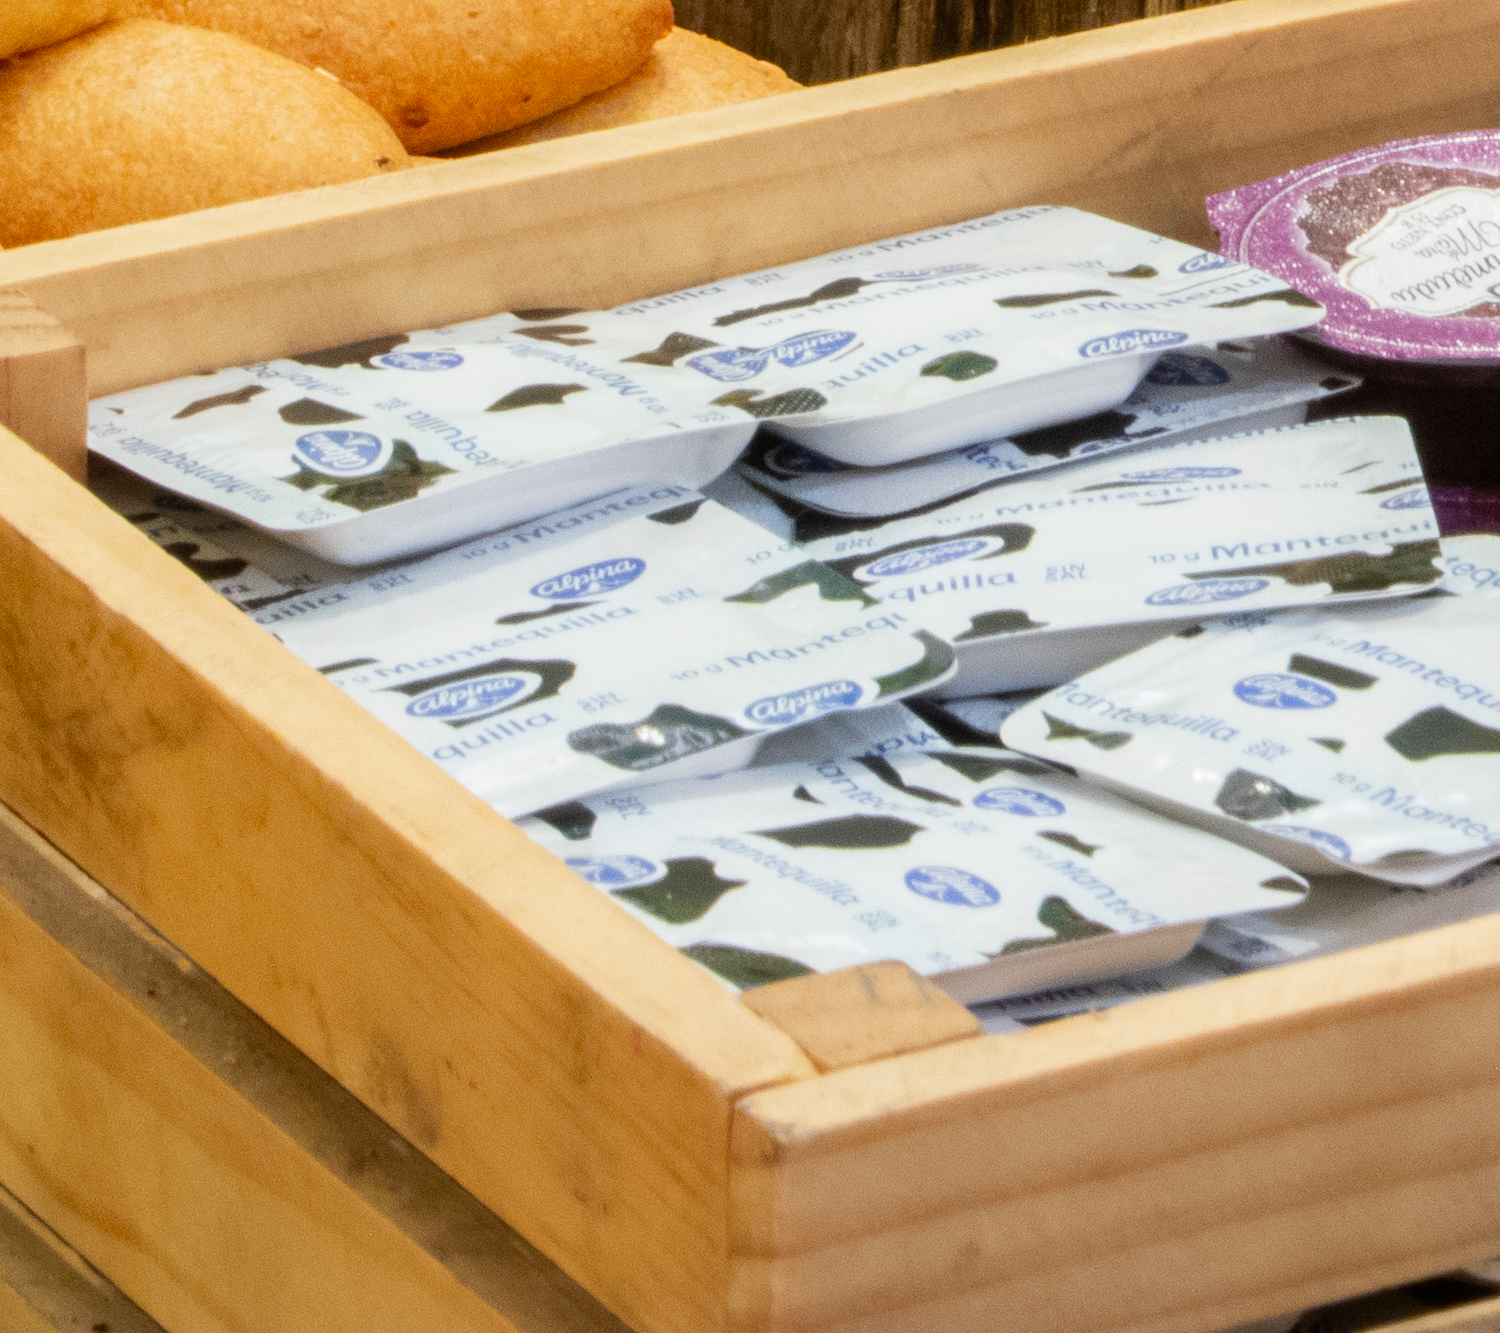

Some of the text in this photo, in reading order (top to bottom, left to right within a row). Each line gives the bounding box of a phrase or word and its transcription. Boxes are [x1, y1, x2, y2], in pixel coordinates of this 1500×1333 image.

[614, 285, 723, 318] quilla
[886, 570, 1017, 604] quilla
[374, 603, 638, 680] Mantequilla
[432, 712, 559, 763] quilla
